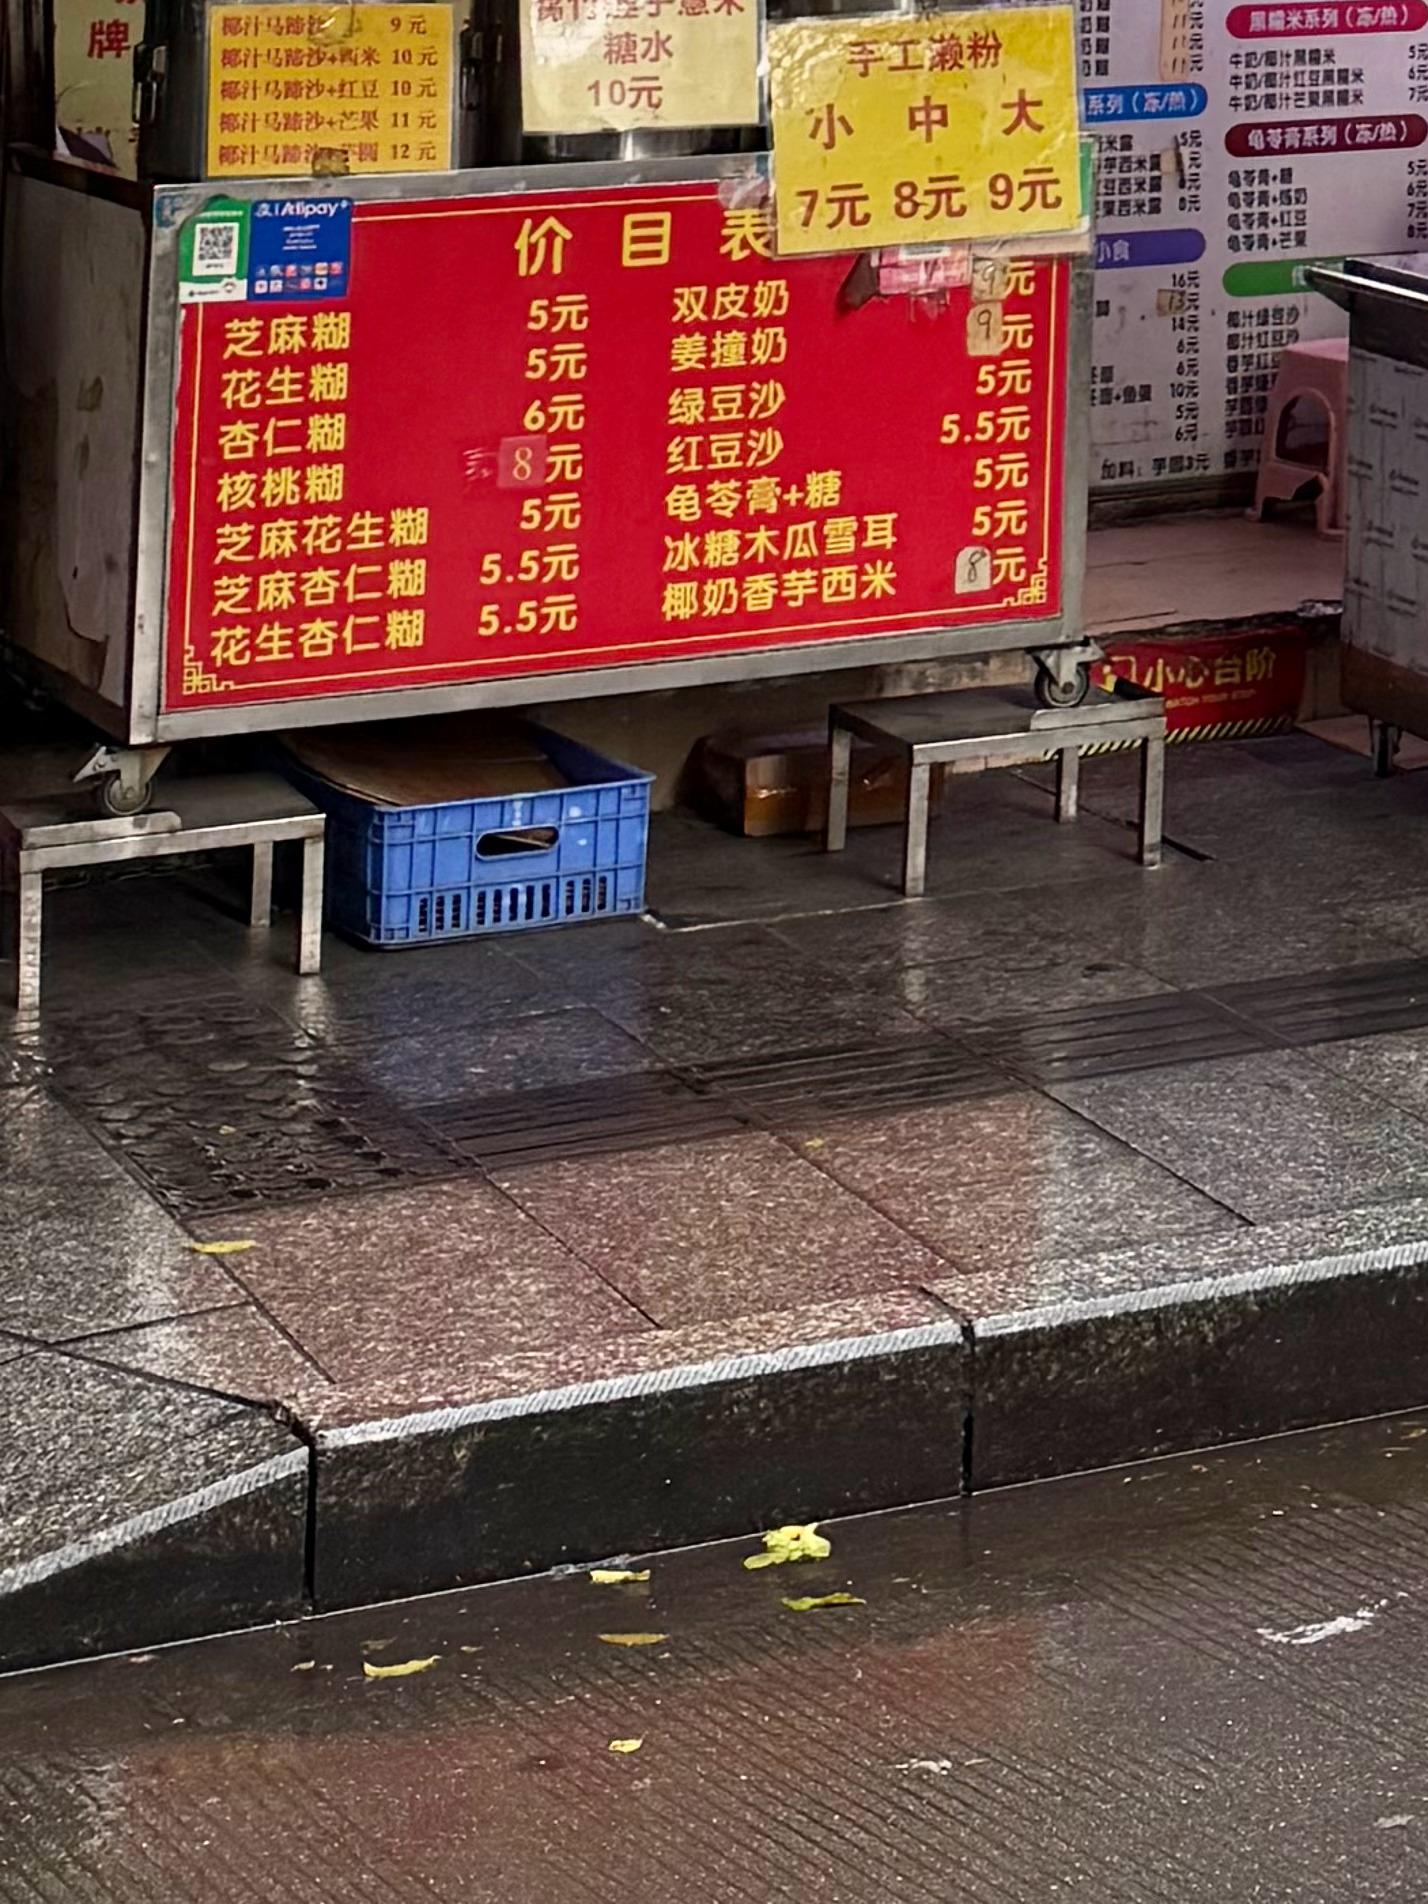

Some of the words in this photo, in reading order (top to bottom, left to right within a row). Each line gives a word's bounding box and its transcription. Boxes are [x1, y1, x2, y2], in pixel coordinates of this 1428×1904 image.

[603, 29, 673, 66] 糖水
[848, 31, 1003, 79] 手工濑粉
[588, 76, 663, 110] 10元
[809, 102, 853, 151] 小
[908, 95, 950, 143] 中
[1002, 89, 1045, 137] 大
[796, 183, 871, 229] 7元
[894, 174, 967, 221] 8元
[989, 166, 1063, 213] 9元
[514, 208, 773, 278] 价目表
[222, 311, 352, 361] 芝麻糊
[527, 294, 589, 333] 5元
[671, 279, 790, 325] 双皮奶
[220, 361, 349, 411] 花生糊
[525, 342, 588, 381] 5元
[670, 326, 788, 373] 姜撞奶
[667, 380, 786, 428] 绿豆沙
[975, 359, 1032, 397] 5元
[218, 413, 347, 461] 杏仁糊
[523, 394, 585, 433] 6元
[666, 428, 784, 476] 红豆沙
[939, 406, 1031, 445] 5.5元
[216, 463, 345, 513] 核桃糊
[511, 443, 583, 483] 8元
[664, 469, 842, 523] 龟苓膏+糖
[973, 453, 1029, 490] 5元
[213, 507, 430, 565] 芝麻花生糊
[519, 492, 581, 532] 5元
[662, 513, 899, 573] 冰糖木瓜雪耳
[971, 499, 1028, 537] 5元
[211, 558, 427, 617] 芝麻杏仁糊
[479, 543, 579, 584] 5.5元
[661, 560, 898, 623] 椰奶香芋西米
[209, 609, 425, 668] 花生杏仁糊
[478, 594, 578, 637] 5.5元
[1142, 646, 1277, 692] 小心台阶
